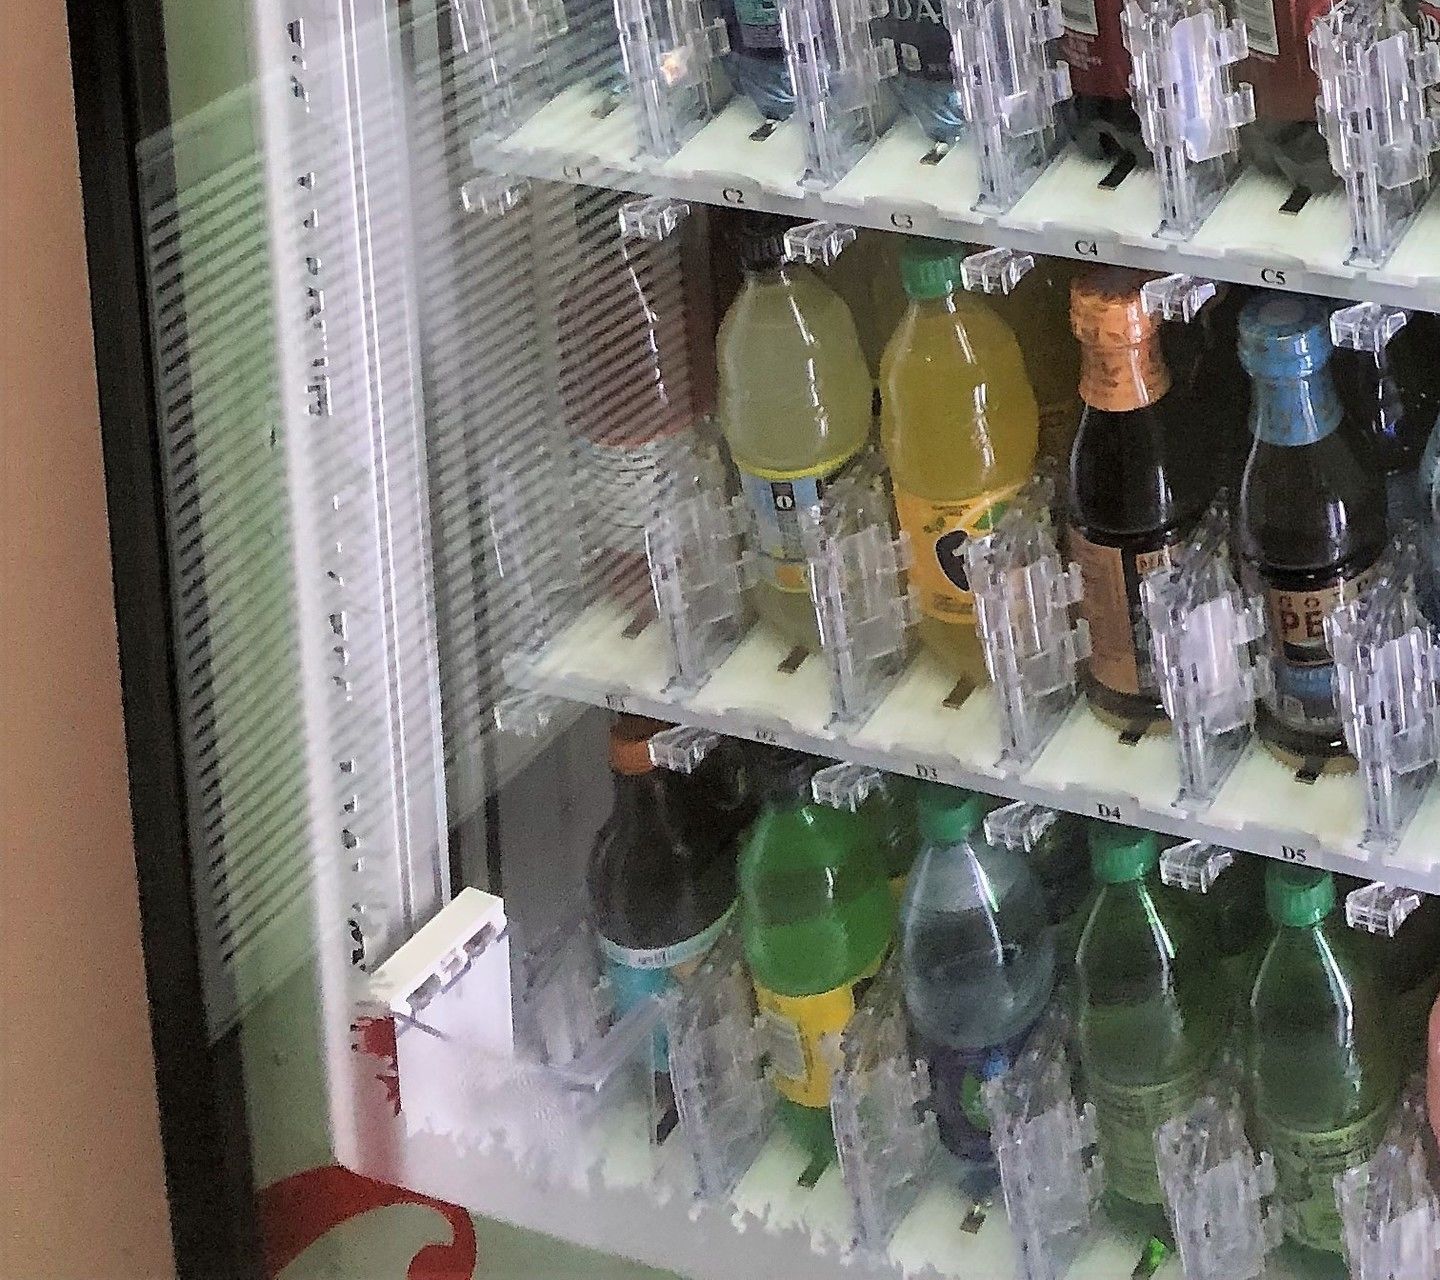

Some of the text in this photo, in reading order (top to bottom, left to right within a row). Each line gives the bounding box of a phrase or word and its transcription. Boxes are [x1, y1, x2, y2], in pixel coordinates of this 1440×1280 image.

[722, 188, 744, 204] C2
[891, 212, 913, 228] C3
[1074, 240, 1098, 256] C4
[1260, 268, 1286, 285] C5
[1096, 803, 1120, 819] D4
[1281, 846, 1307, 862] D5
